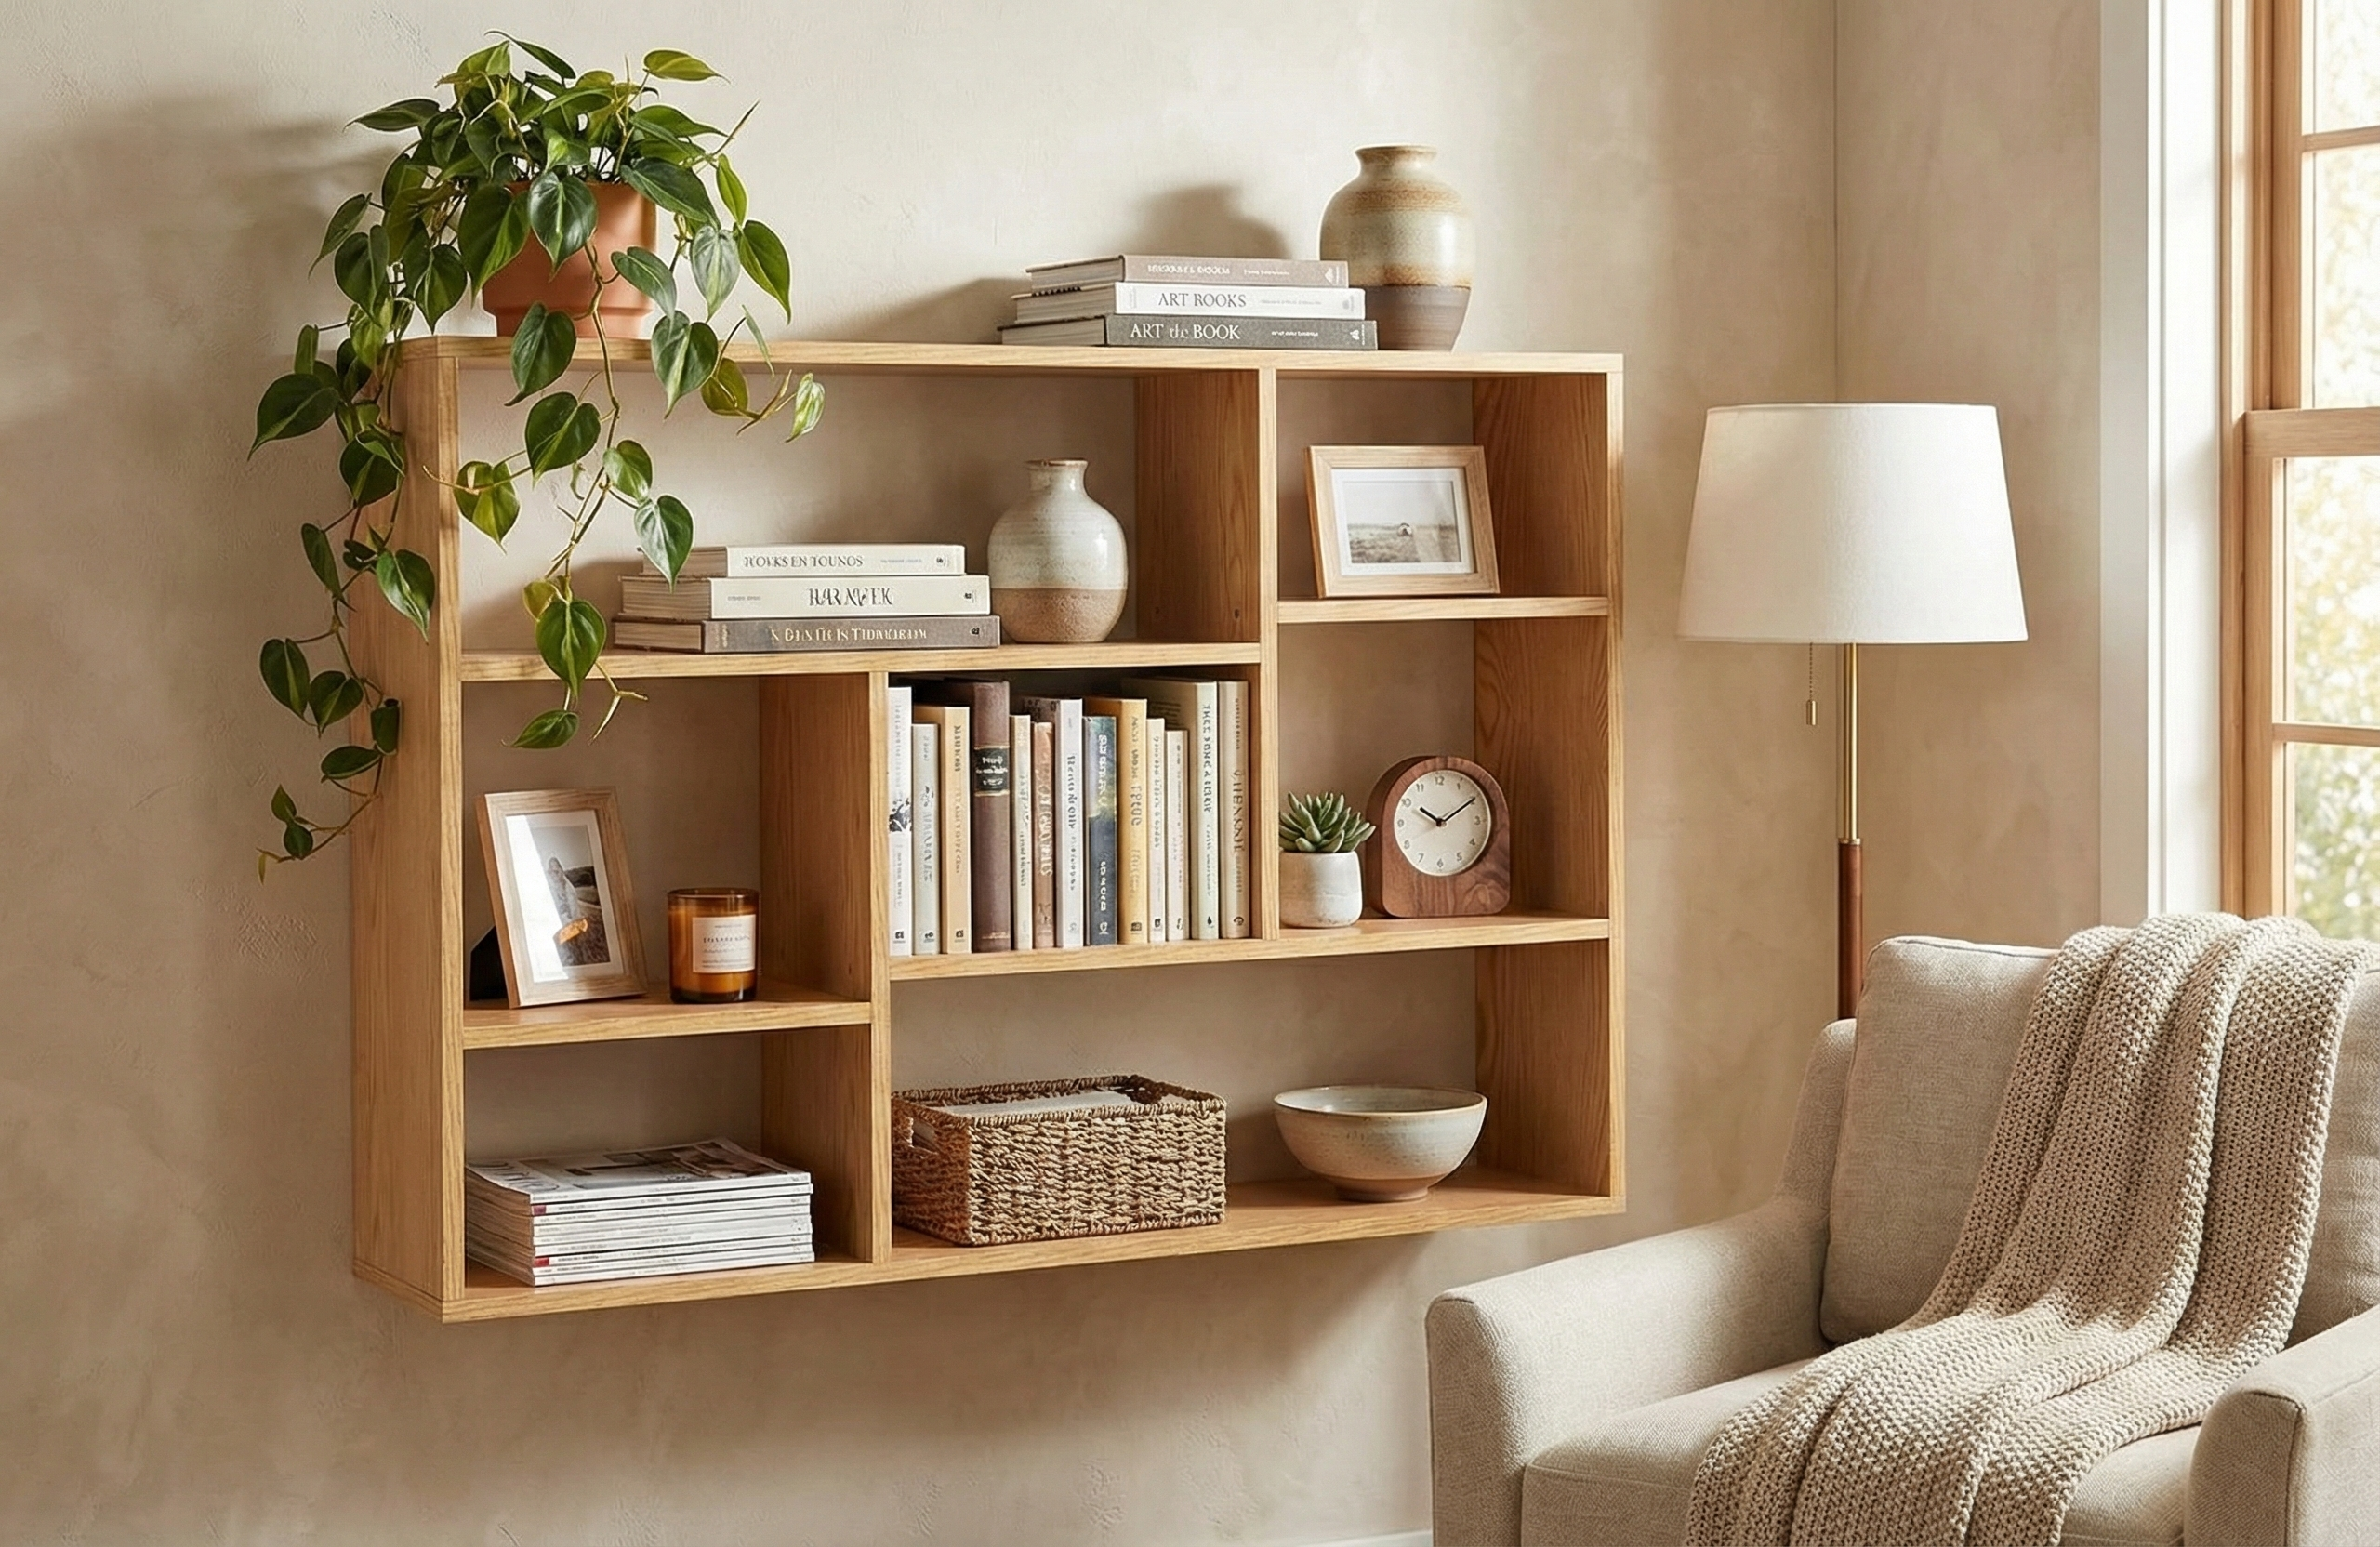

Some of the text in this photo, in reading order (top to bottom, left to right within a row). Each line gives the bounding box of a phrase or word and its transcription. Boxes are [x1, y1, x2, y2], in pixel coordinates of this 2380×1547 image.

[1157, 292, 1189, 307] ART
[1130, 323, 1164, 338] ART
[1193, 324, 1241, 340] BOOK
[1435, 775, 1445, 786] 12
[1416, 783, 1424, 793] 11
[1474, 815, 1481, 826] 3
[1469, 838, 1476, 846] 4
[1418, 853, 1424, 863] 7
[1456, 852, 1462, 862] 5
[1436, 858, 1444, 868] 6
